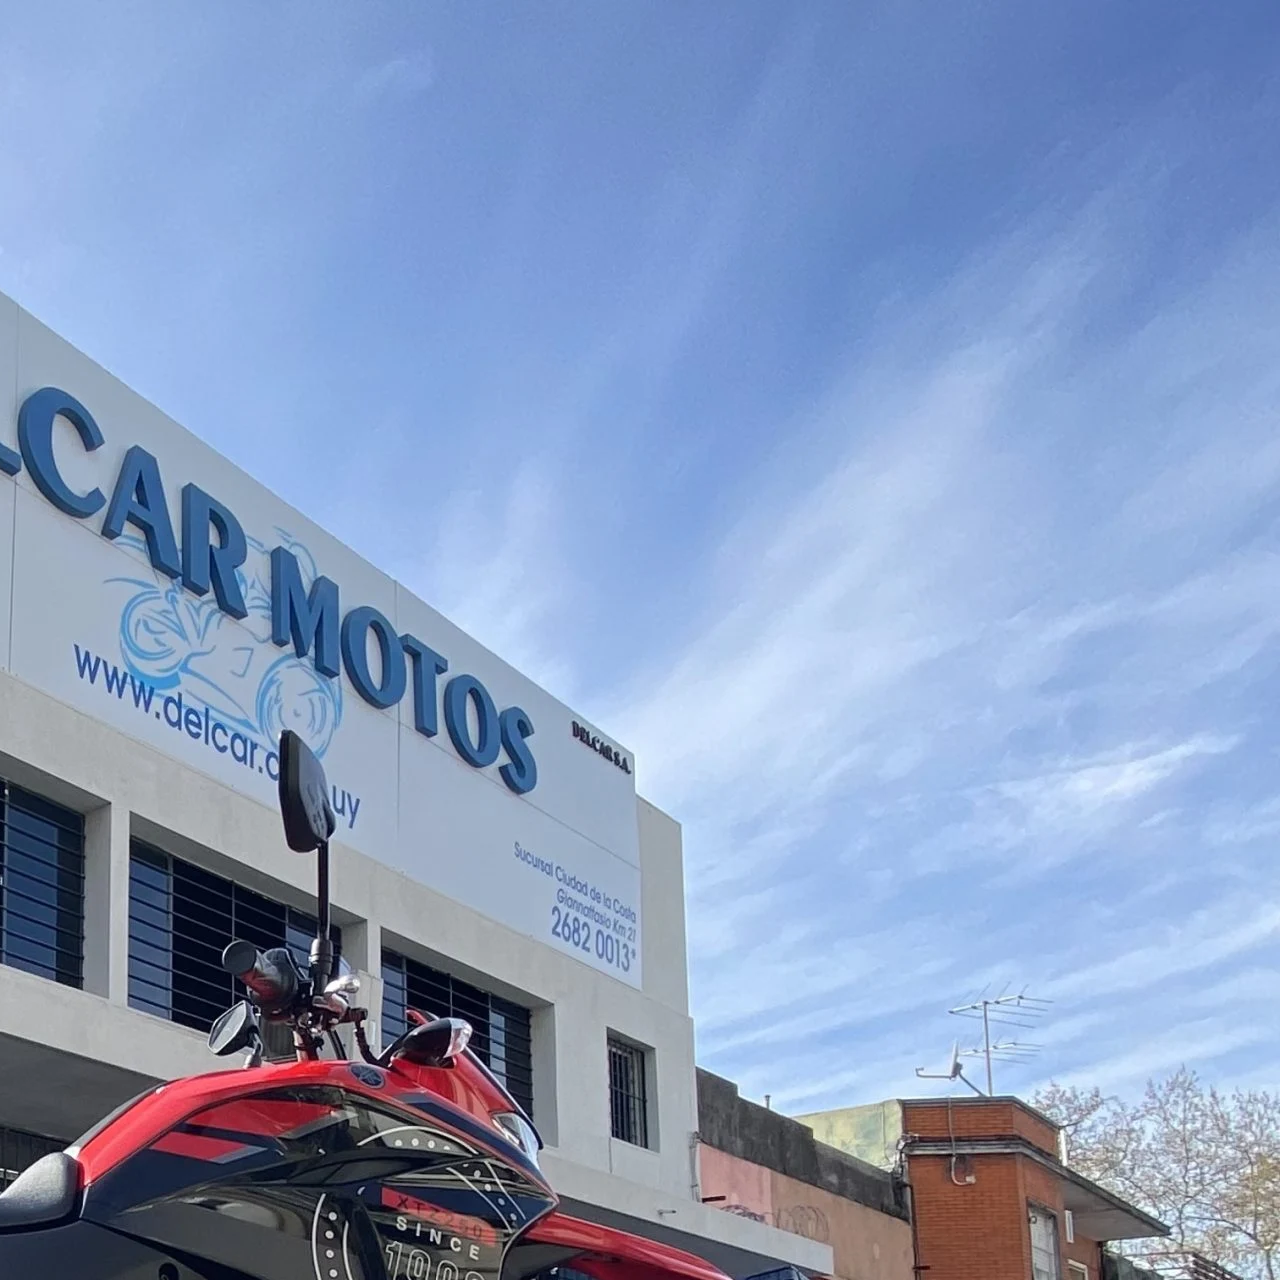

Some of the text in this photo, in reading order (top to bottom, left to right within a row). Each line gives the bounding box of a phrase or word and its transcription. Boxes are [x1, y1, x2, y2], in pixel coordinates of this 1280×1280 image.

[271, 546, 537, 795] MOTOS
[571, 720, 613, 762] DELCAR
[514, 841, 636, 923] Sucursal Ciudad de la Costa
[552, 905, 590, 953] 2682
[557, 888, 611, 929] Giannattasio
[612, 918, 626, 937] Km
[396, 1215, 480, 1261] SINCE
